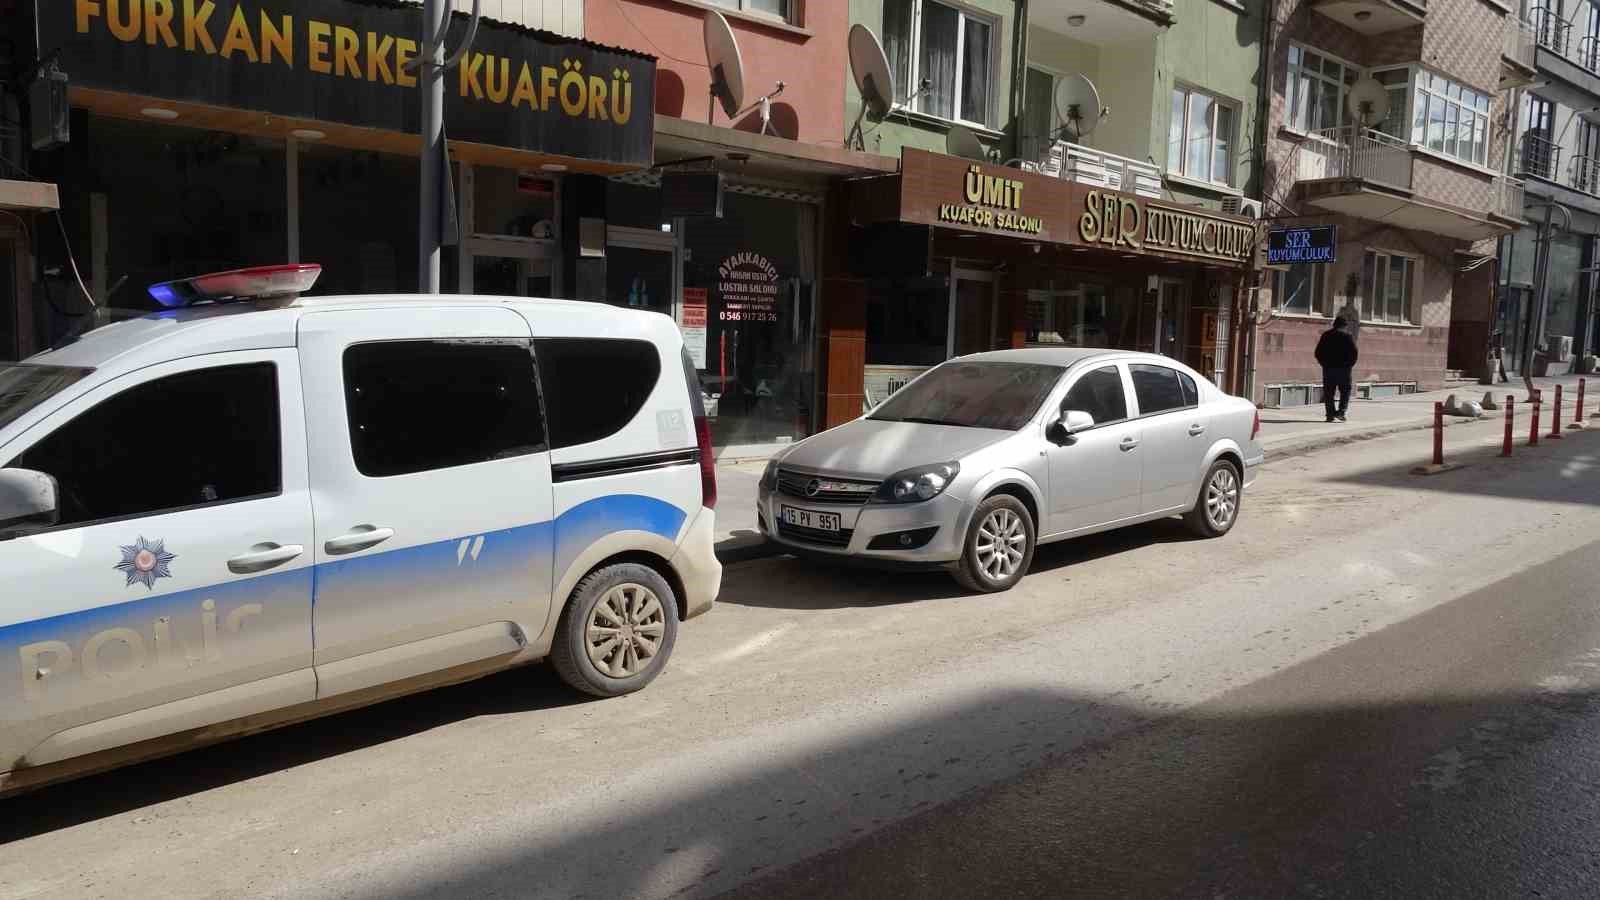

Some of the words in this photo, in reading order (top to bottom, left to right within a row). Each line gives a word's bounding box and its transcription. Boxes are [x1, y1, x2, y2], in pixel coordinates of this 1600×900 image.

[74, 0, 294, 70] FURKAN
[308, 20, 424, 88] ERKE
[460, 48, 632, 125] KUAFÖRÜ
[997, 213, 1042, 233] SALONU
[1080, 190, 1140, 248] SER
[1145, 208, 1253, 258] KUYUMCULUK
[1285, 231, 1312, 248] SER
[1268, 247, 1330, 262] KUYUMCULUK
[719, 311, 726, 321] 0
[726, 311, 741, 321] 546
[786, 508, 797, 523] 15
[800, 511, 811, 526] PV
[819, 515, 838, 531] 951
